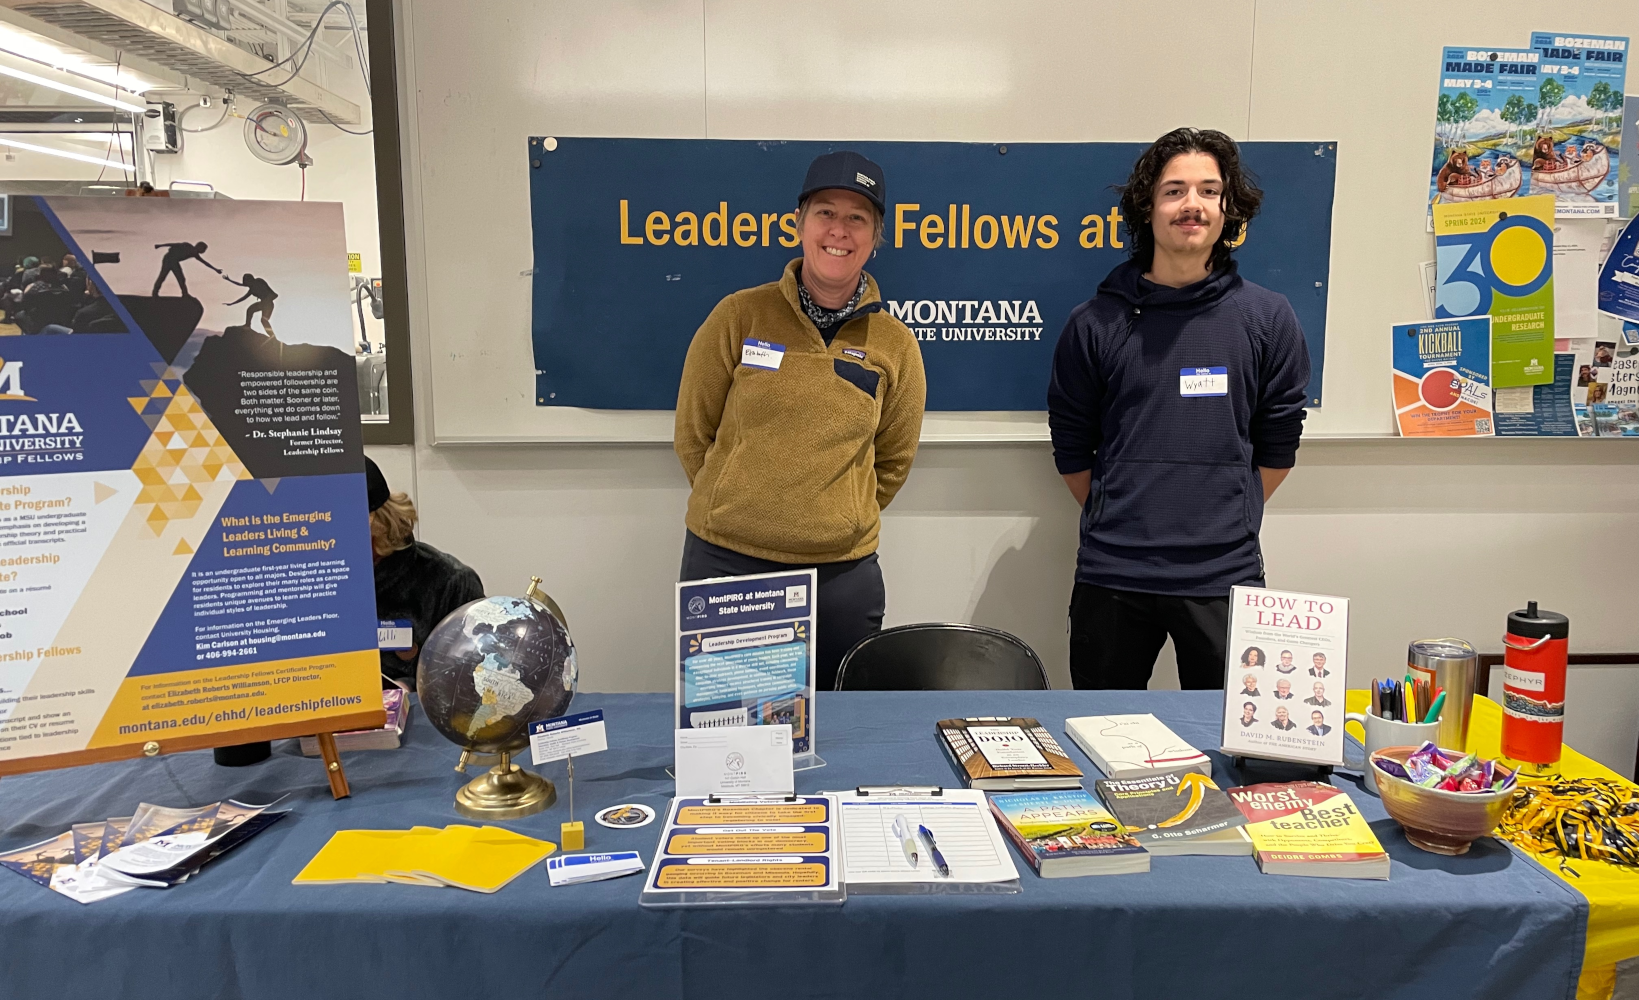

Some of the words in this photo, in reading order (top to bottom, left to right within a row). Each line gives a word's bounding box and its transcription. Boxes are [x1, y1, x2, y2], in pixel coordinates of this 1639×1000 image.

[1554, 37, 1626, 50] BOZEMAN
[1586, 50, 1624, 62] FAIR
[1446, 62, 1494, 73] MADE
[1499, 64, 1537, 74] FAIR
[1561, 66, 1579, 74] 3-4
[1444, 79, 1473, 88] MAY
[1474, 80, 1492, 88] 3-4
[619, 199, 801, 248] Leaders
[894, 203, 1059, 250] Fellows
[1078, 206, 1124, 250] at
[1444, 218, 1468, 228] SPRING
[1470, 217, 1486, 226] 2024
[887, 300, 1043, 324] MONTANA
[1492, 312, 1544, 324] UNDERGRADUATE
[1512, 322, 1544, 331] RESEARCH
[942, 328, 1044, 341] UNIVERSITY
[758, 340, 770, 348] Hello
[1418, 331, 1462, 354] KICKBALL
[1419, 352, 1462, 360] TOURNAMENT
[286, 370, 322, 378] leadership
[1460, 366, 1488, 380] SPONSORED
[284, 378, 325, 386] followership
[1185, 378, 1215, 390] Wyatt
[0, 412, 84, 435] TANA
[252, 430, 266, 438] Dr.
[268, 428, 309, 439] Stephanie
[311, 427, 342, 436] Lindsay
[18, 452, 84, 464] FELLOWS
[284, 448, 319, 456] Leadership
[14, 497, 72, 511] Program?
[222, 516, 250, 527] What
[252, 516, 260, 524] is
[263, 514, 280, 524] the
[282, 511, 332, 523] Emerging
[222, 528, 265, 542] Leaders
[268, 527, 298, 539] Living
[300, 526, 308, 536] &
[224, 545, 270, 557] Learning
[272, 539, 336, 553] Community?
[708, 593, 743, 604] MontPIRG
[754, 590, 784, 599] Montana
[718, 606, 738, 615] State
[740, 602, 776, 614] University
[1245, 594, 1298, 610] HOW
[1304, 600, 1334, 614] TO
[1256, 610, 1322, 631] LEAD
[196, 642, 210, 650] Kim
[212, 639, 238, 650] Carlson
[240, 638, 248, 646] at
[248, 630, 326, 645] housing@montana.edu
[708, 640, 734, 648] Leadership
[736, 636, 767, 644] Development
[37, 645, 82, 658] Fellows
[206, 646, 258, 660] 406-994-2661
[1504, 672, 1542, 685] ZEPHYR
[168, 688, 200, 698] Elizabeth
[202, 684, 230, 693] Roberts
[232, 680, 272, 690] Williamson,
[274, 676, 291, 684] LFCP
[119, 695, 362, 734] montana.edu/ehhd/leadershipfellows
[978, 735, 1024, 743] DOJO
[1240, 731, 1264, 740] DAVID
[1276, 736, 1325, 746] RUBENSTEIN
[1106, 780, 1165, 792] Theory
[1166, 776, 1180, 784] U
[1120, 776, 1164, 784] Essentials
[1130, 788, 1160, 796] Principles
[1232, 788, 1300, 803] Worst
[1040, 804, 1082, 812] PATH
[1250, 798, 1313, 811] enemy
[1020, 810, 1098, 820] APPEARS
[1300, 802, 1356, 821] Best
[1185, 821, 1228, 836] Scharmer
[1270, 816, 1351, 830] teacher
